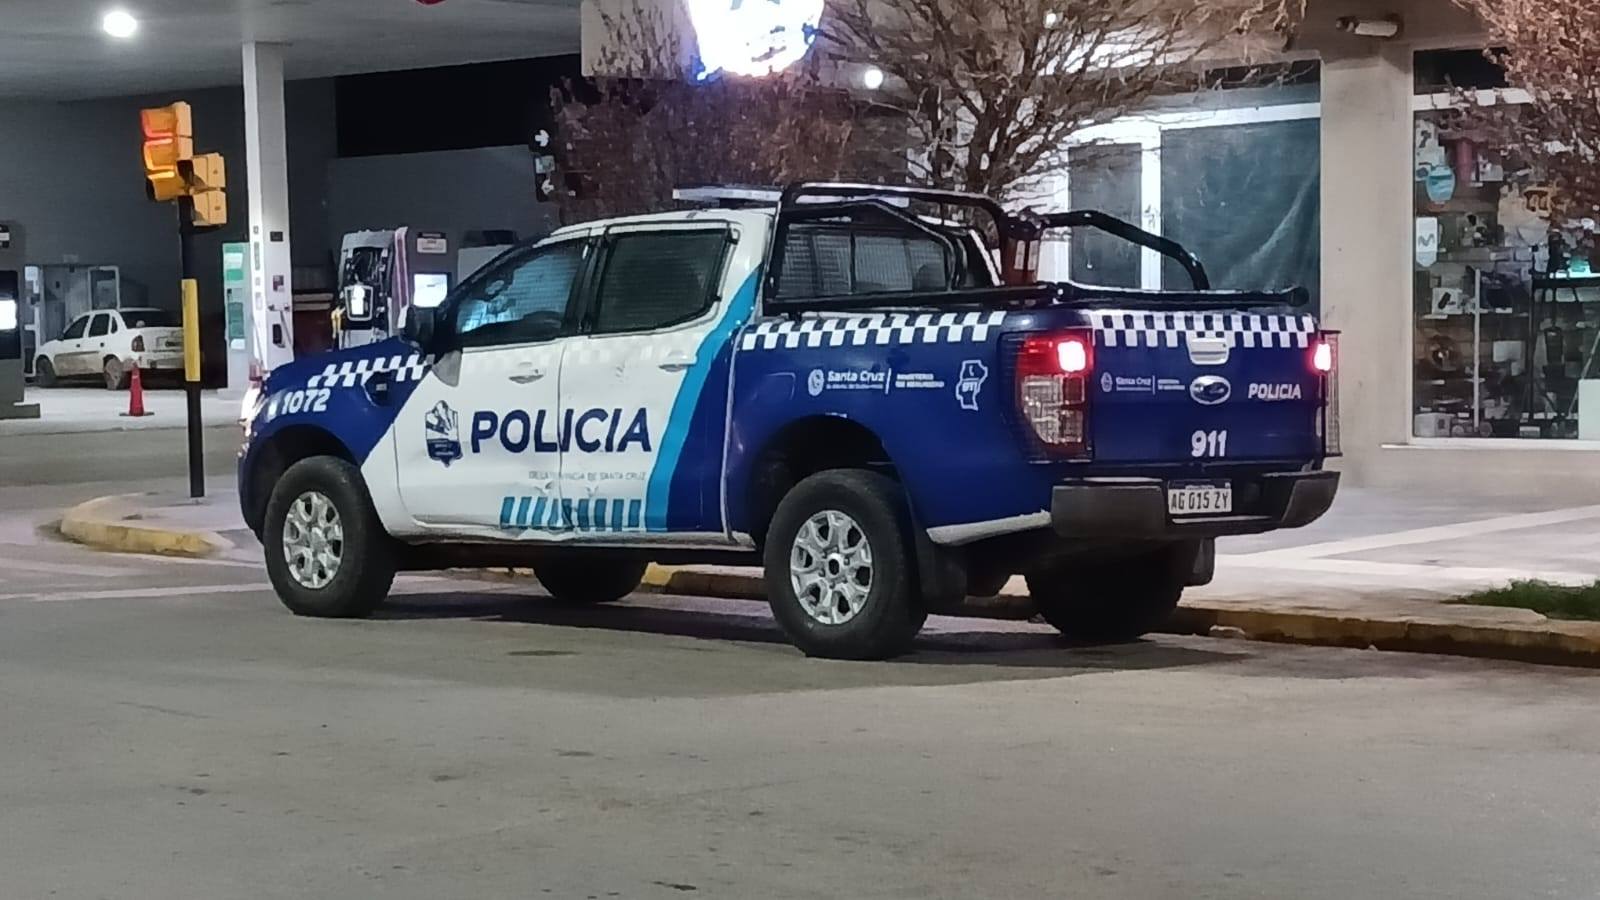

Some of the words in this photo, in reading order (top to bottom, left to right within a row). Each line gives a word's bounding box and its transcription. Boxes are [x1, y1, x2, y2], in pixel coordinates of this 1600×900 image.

[827, 370, 858, 382] Santa
[860, 370, 885, 384] Cruz
[281, 388, 331, 415] 1072
[1248, 383, 1302, 399] POLICIA
[471, 407, 652, 453] POLICIA
[1191, 430, 1227, 457] 911
[1170, 493, 1186, 511] AG
[1188, 491, 1211, 510] 015
[1214, 491, 1228, 509] ZY
